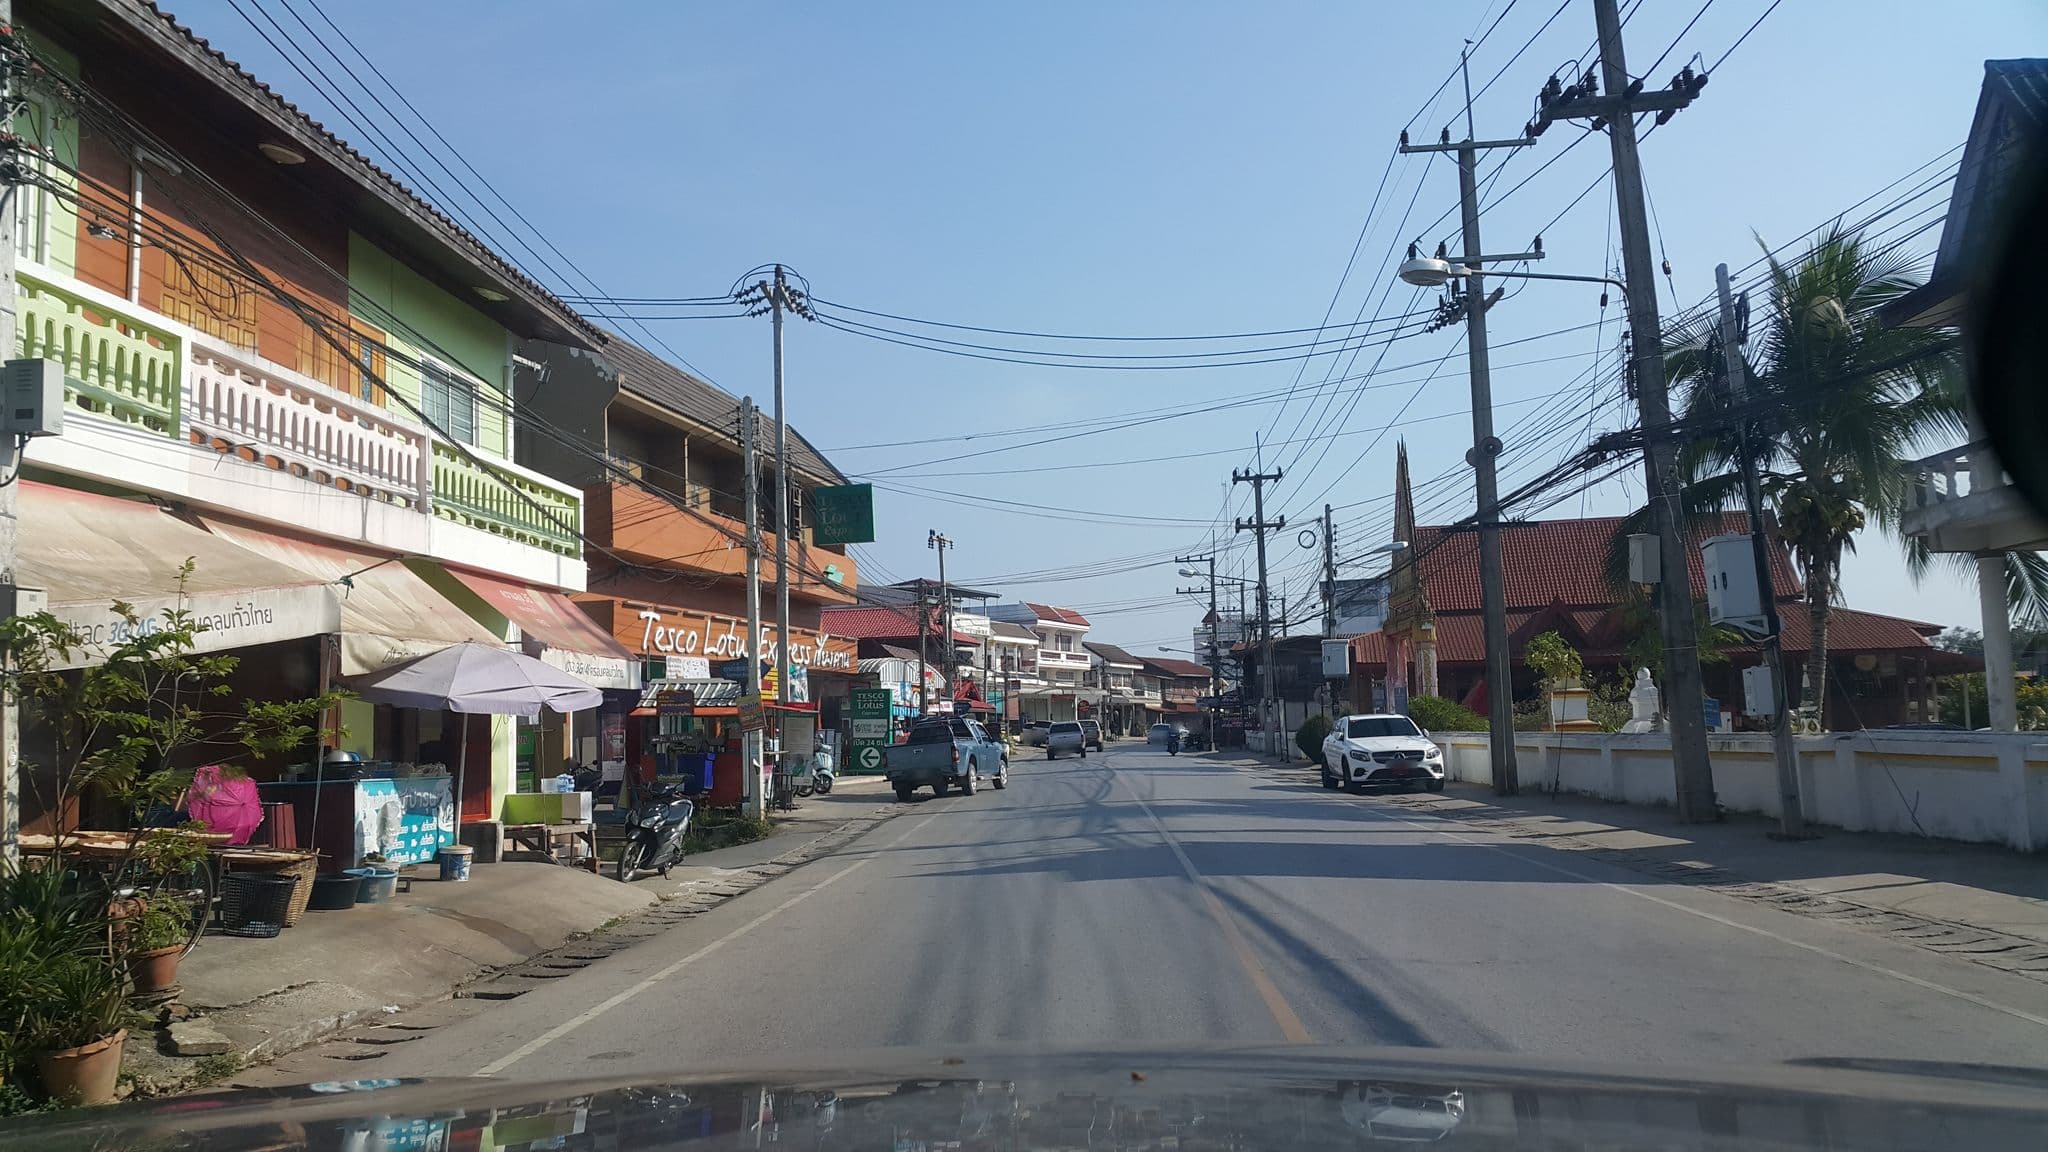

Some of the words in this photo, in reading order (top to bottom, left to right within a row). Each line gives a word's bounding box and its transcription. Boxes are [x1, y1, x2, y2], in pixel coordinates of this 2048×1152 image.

[639, 610, 697, 654] Tesco
[703, 618, 750, 658] Lotu
[760, 627, 811, 667] Exress
